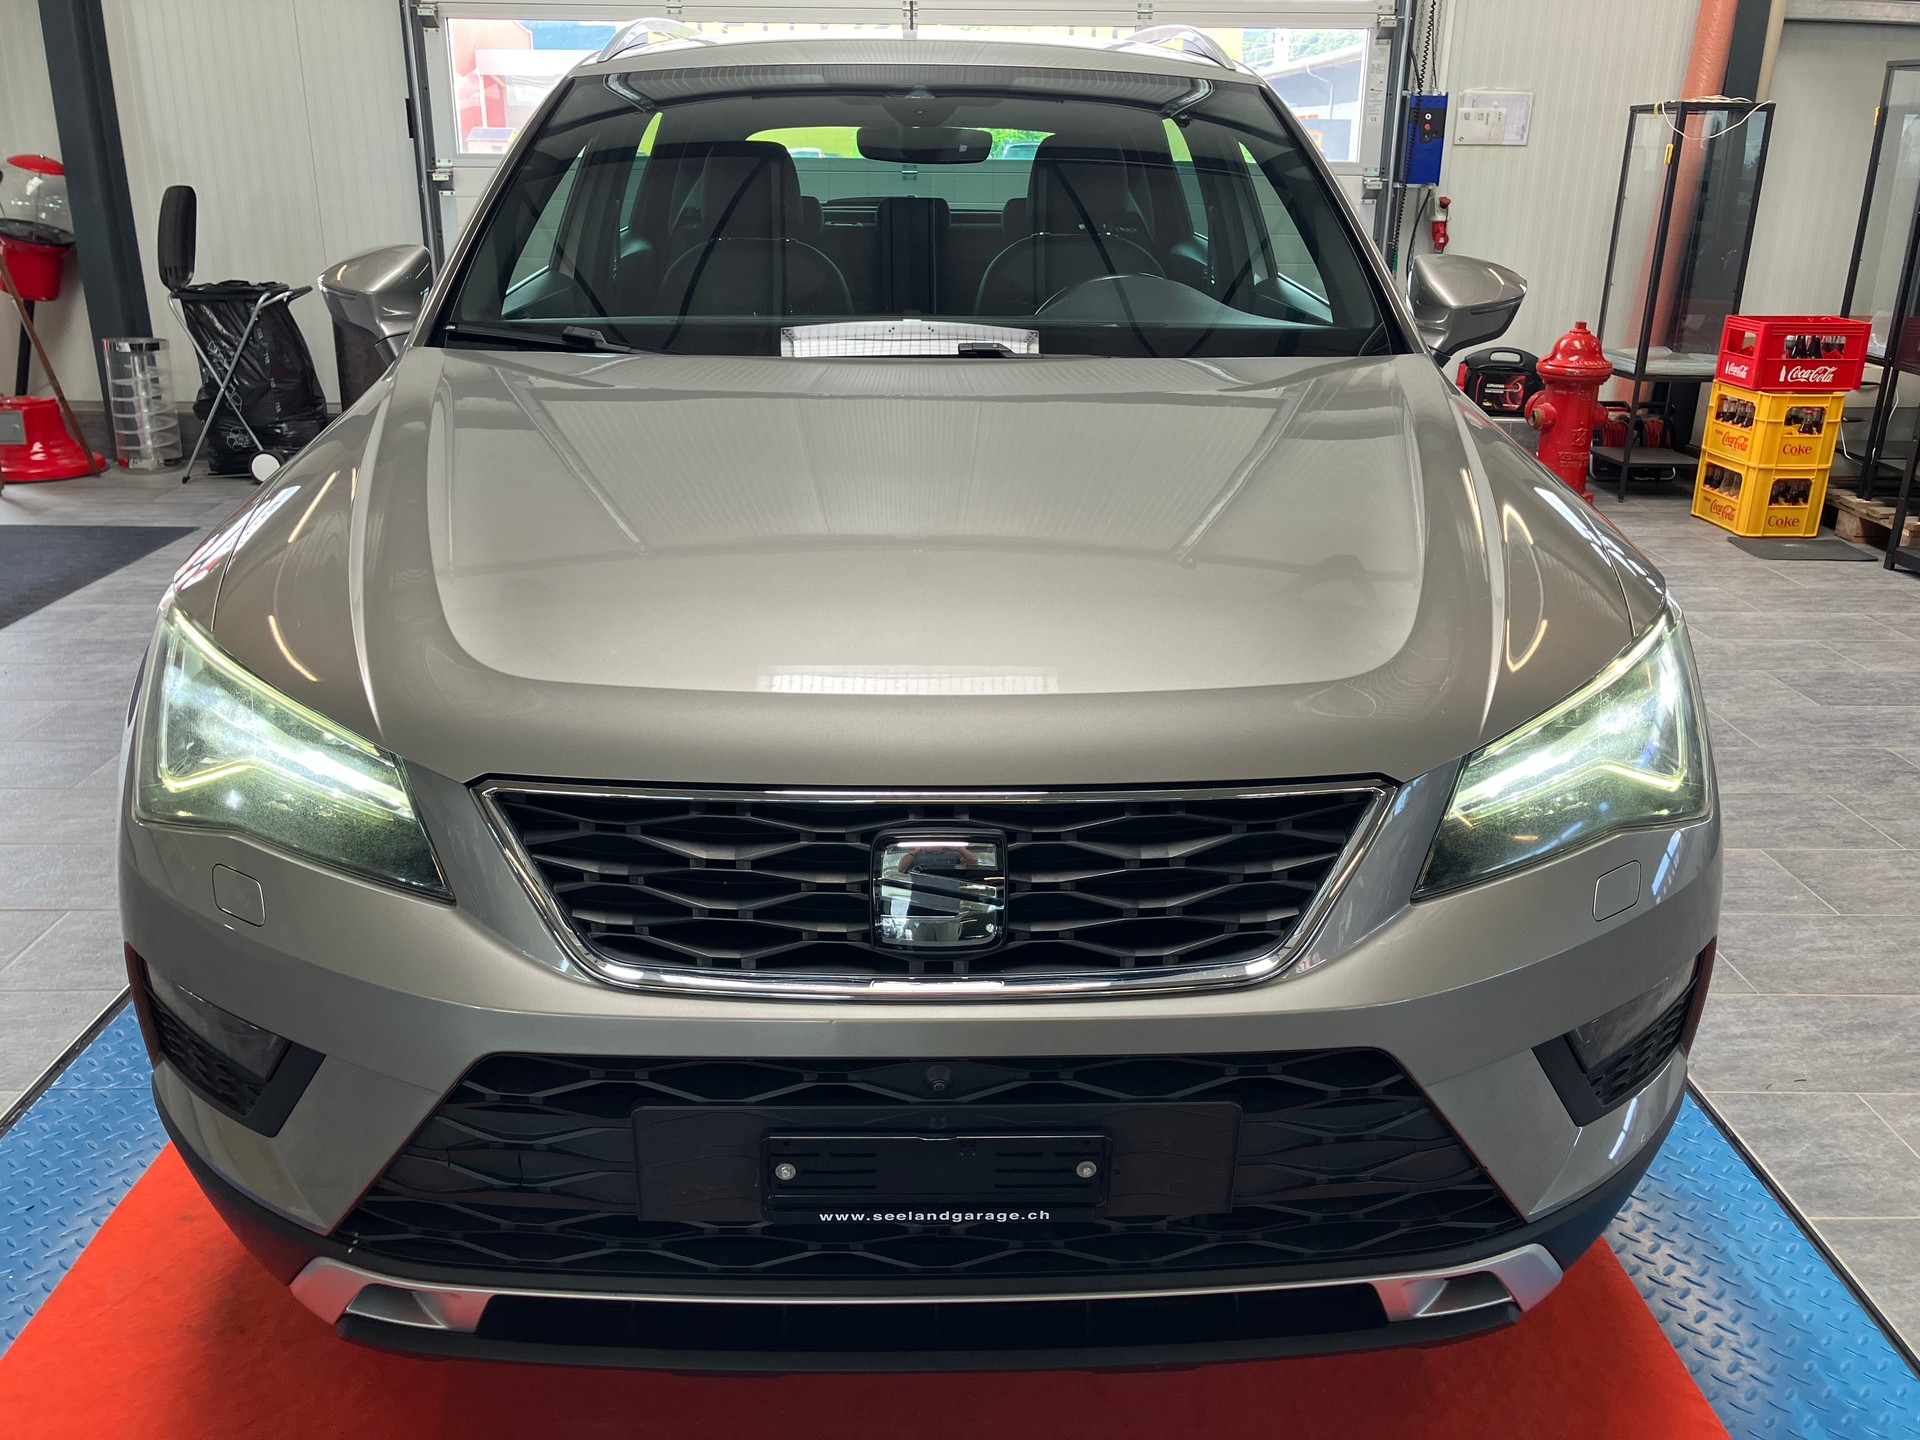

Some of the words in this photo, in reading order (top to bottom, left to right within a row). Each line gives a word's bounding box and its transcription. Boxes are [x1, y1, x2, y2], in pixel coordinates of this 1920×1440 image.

[1787, 365, 1838, 383] Coca-Cola
[1722, 431, 1748, 451] Coca-Cola
[1783, 444, 1812, 455] Coke
[1767, 515, 1800, 527] Coke
[818, 1210, 1050, 1223] www.seelandgarage.ch
